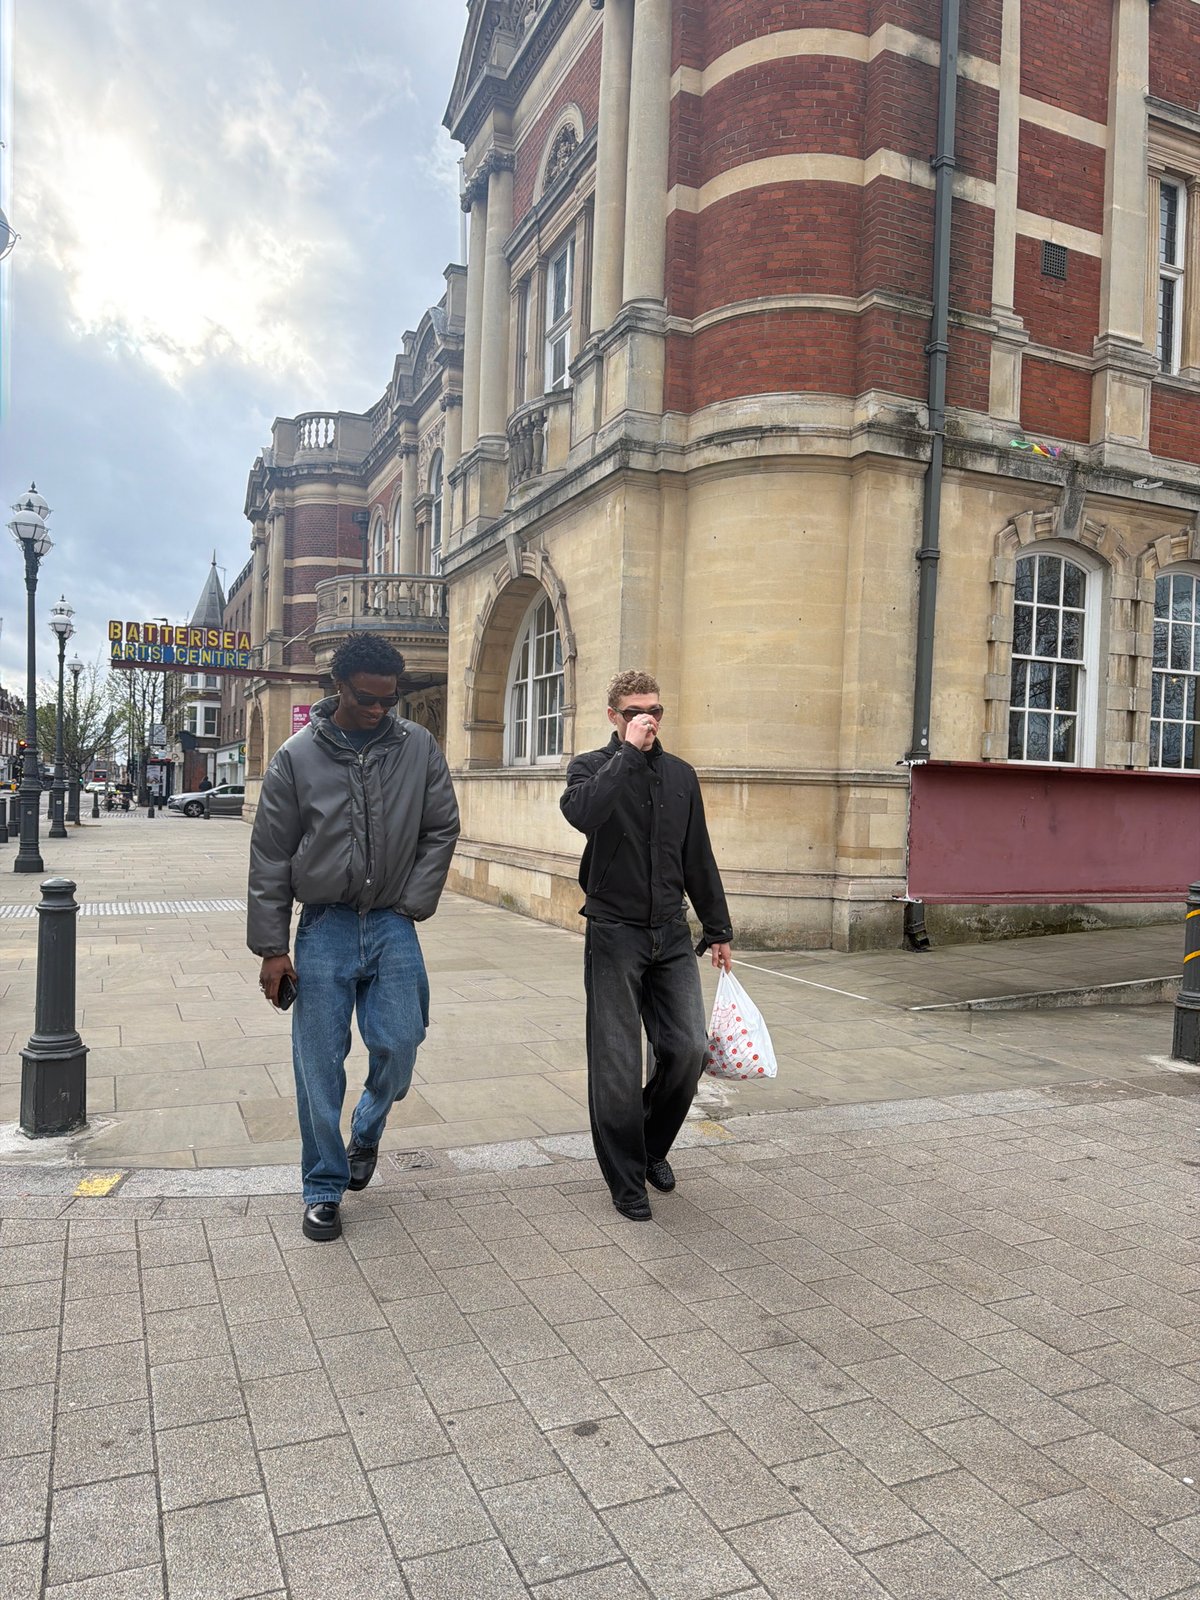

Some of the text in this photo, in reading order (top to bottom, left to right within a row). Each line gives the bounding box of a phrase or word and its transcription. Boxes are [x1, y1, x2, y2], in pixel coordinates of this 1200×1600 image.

[110, 621, 249, 649] BATTERSEA
[112, 643, 248, 667] ARTS CENTRE
